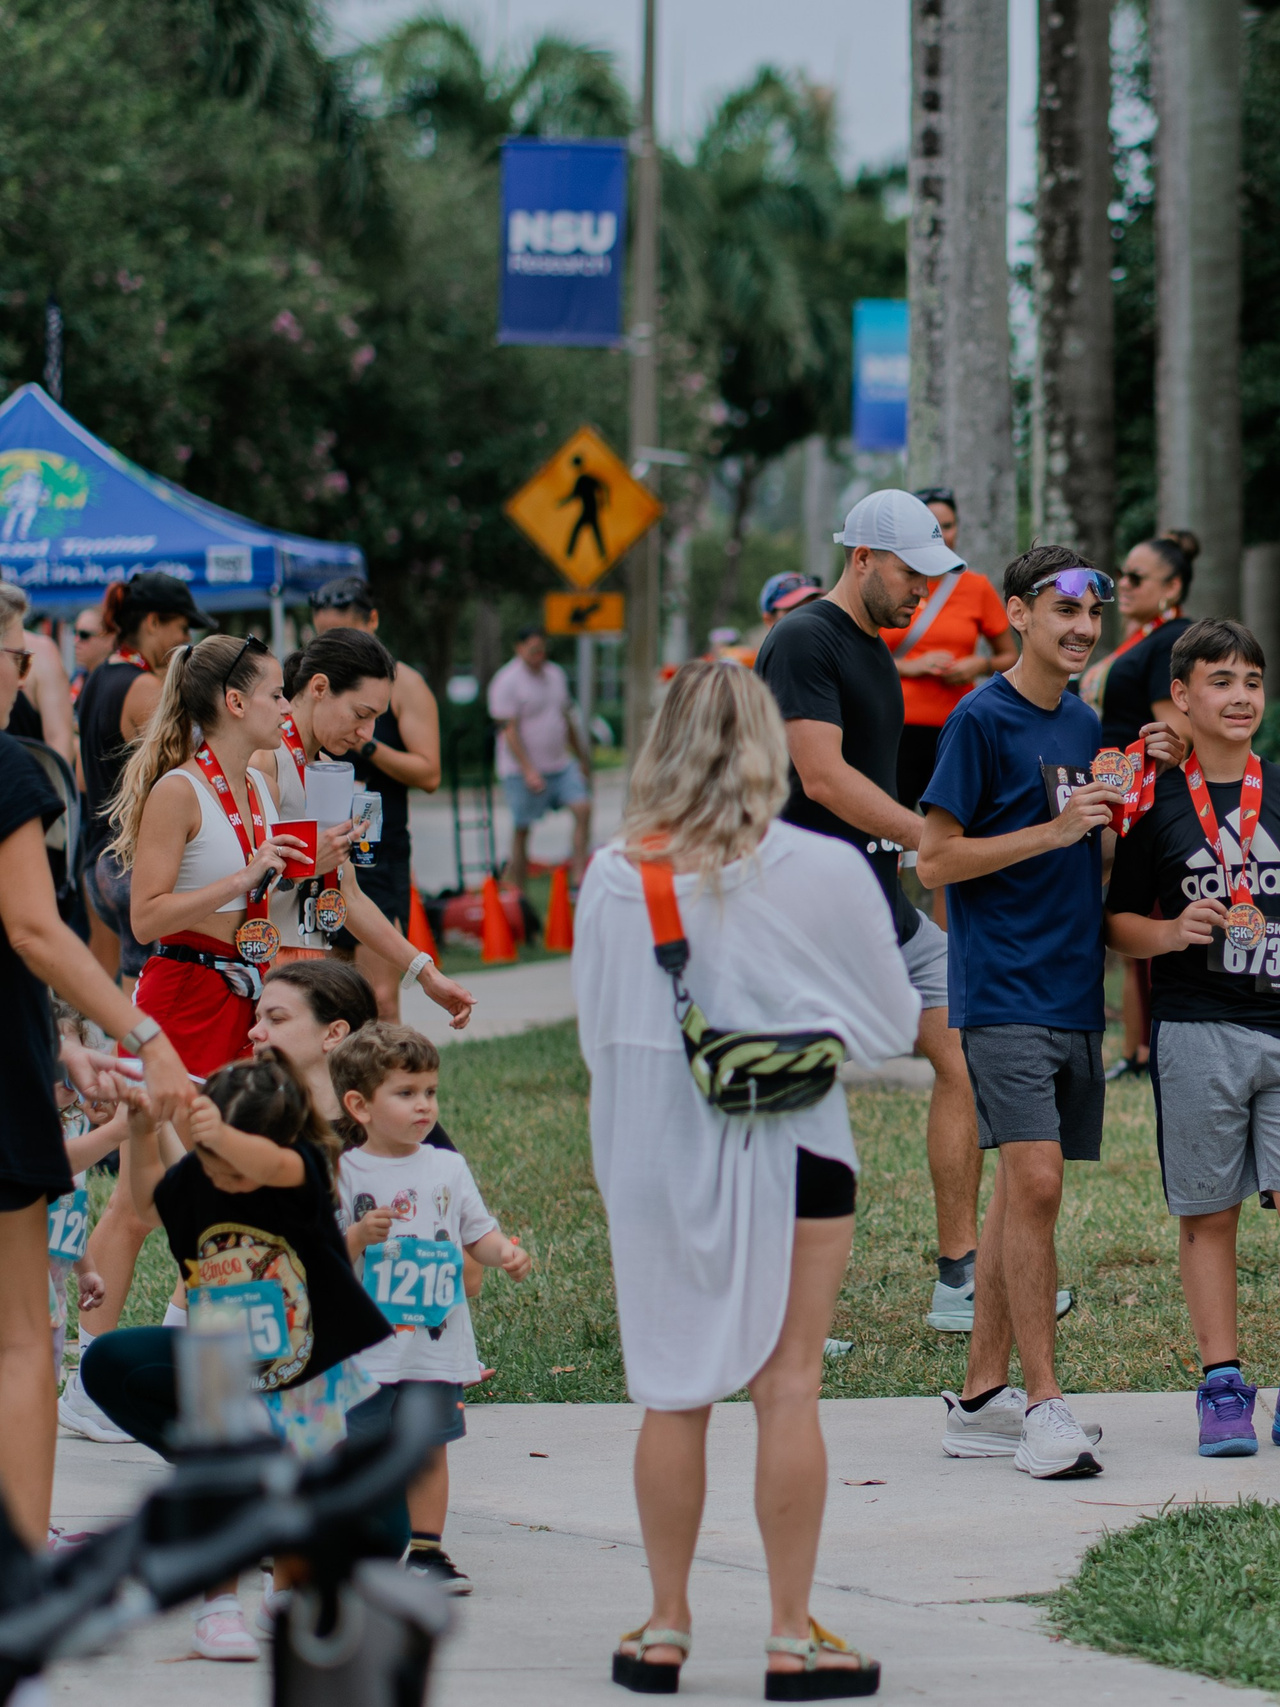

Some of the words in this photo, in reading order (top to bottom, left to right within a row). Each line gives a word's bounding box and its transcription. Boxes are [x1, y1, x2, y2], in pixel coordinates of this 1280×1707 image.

[508, 209, 617, 254] NSU
[1076, 772, 1086, 784] 5K
[1244, 775, 1260, 789] 5K
[229, 812, 242, 827] 5K
[1234, 926, 1248, 939] 5K
[246, 941, 261, 953] 5K
[416, 1249, 435, 1258] Taco
[200, 1257, 242, 1282] Cinco
[372, 1259, 457, 1307] 1216
[402, 1313, 425, 1322] TACO
